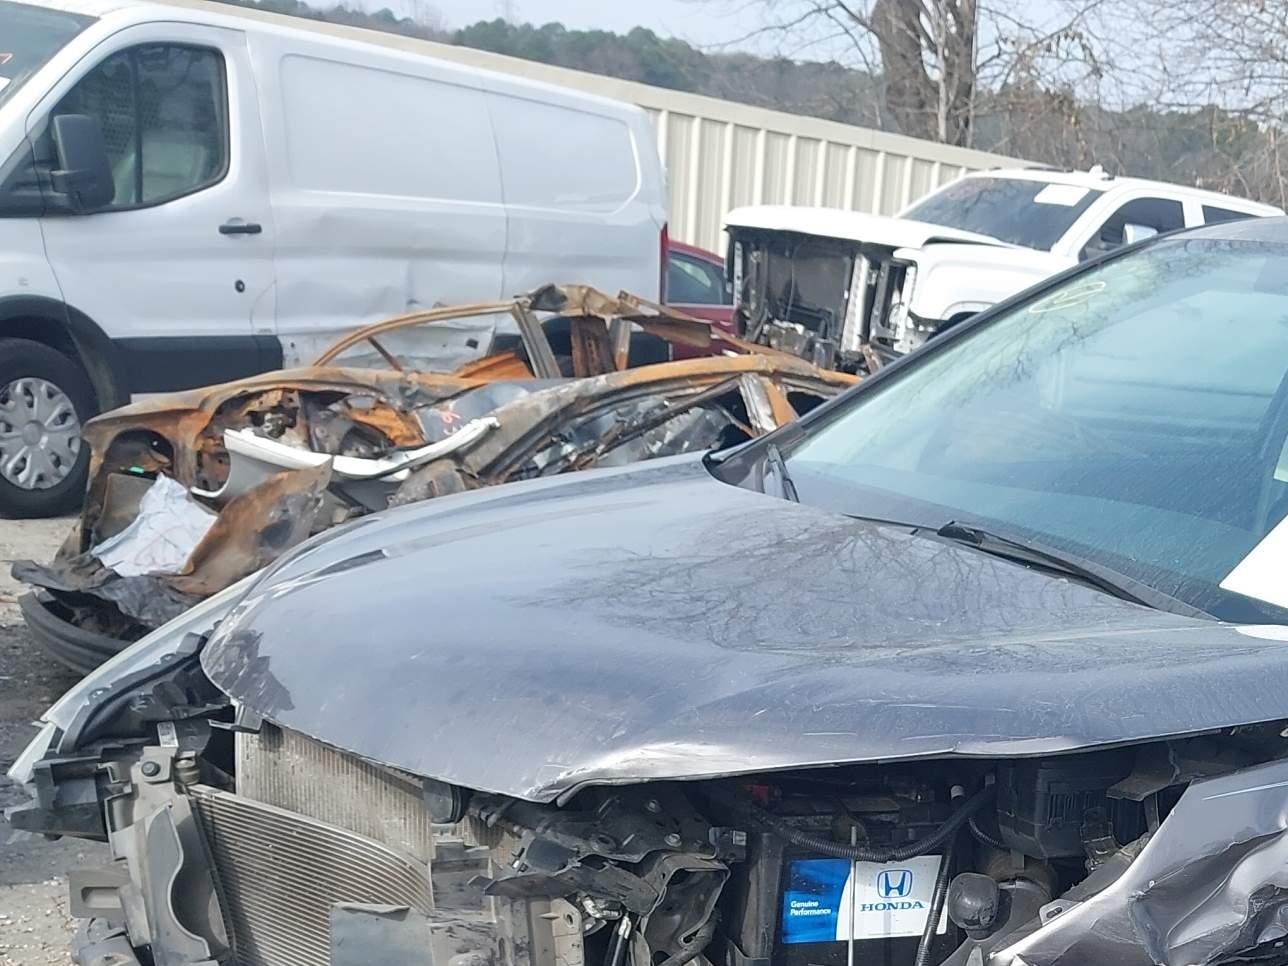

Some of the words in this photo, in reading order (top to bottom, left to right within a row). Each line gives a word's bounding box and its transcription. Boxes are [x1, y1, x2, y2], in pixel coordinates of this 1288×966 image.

[789, 900, 819, 908] Genuine
[860, 901, 925, 912] HONDA
[790, 908, 832, 916] Performance
